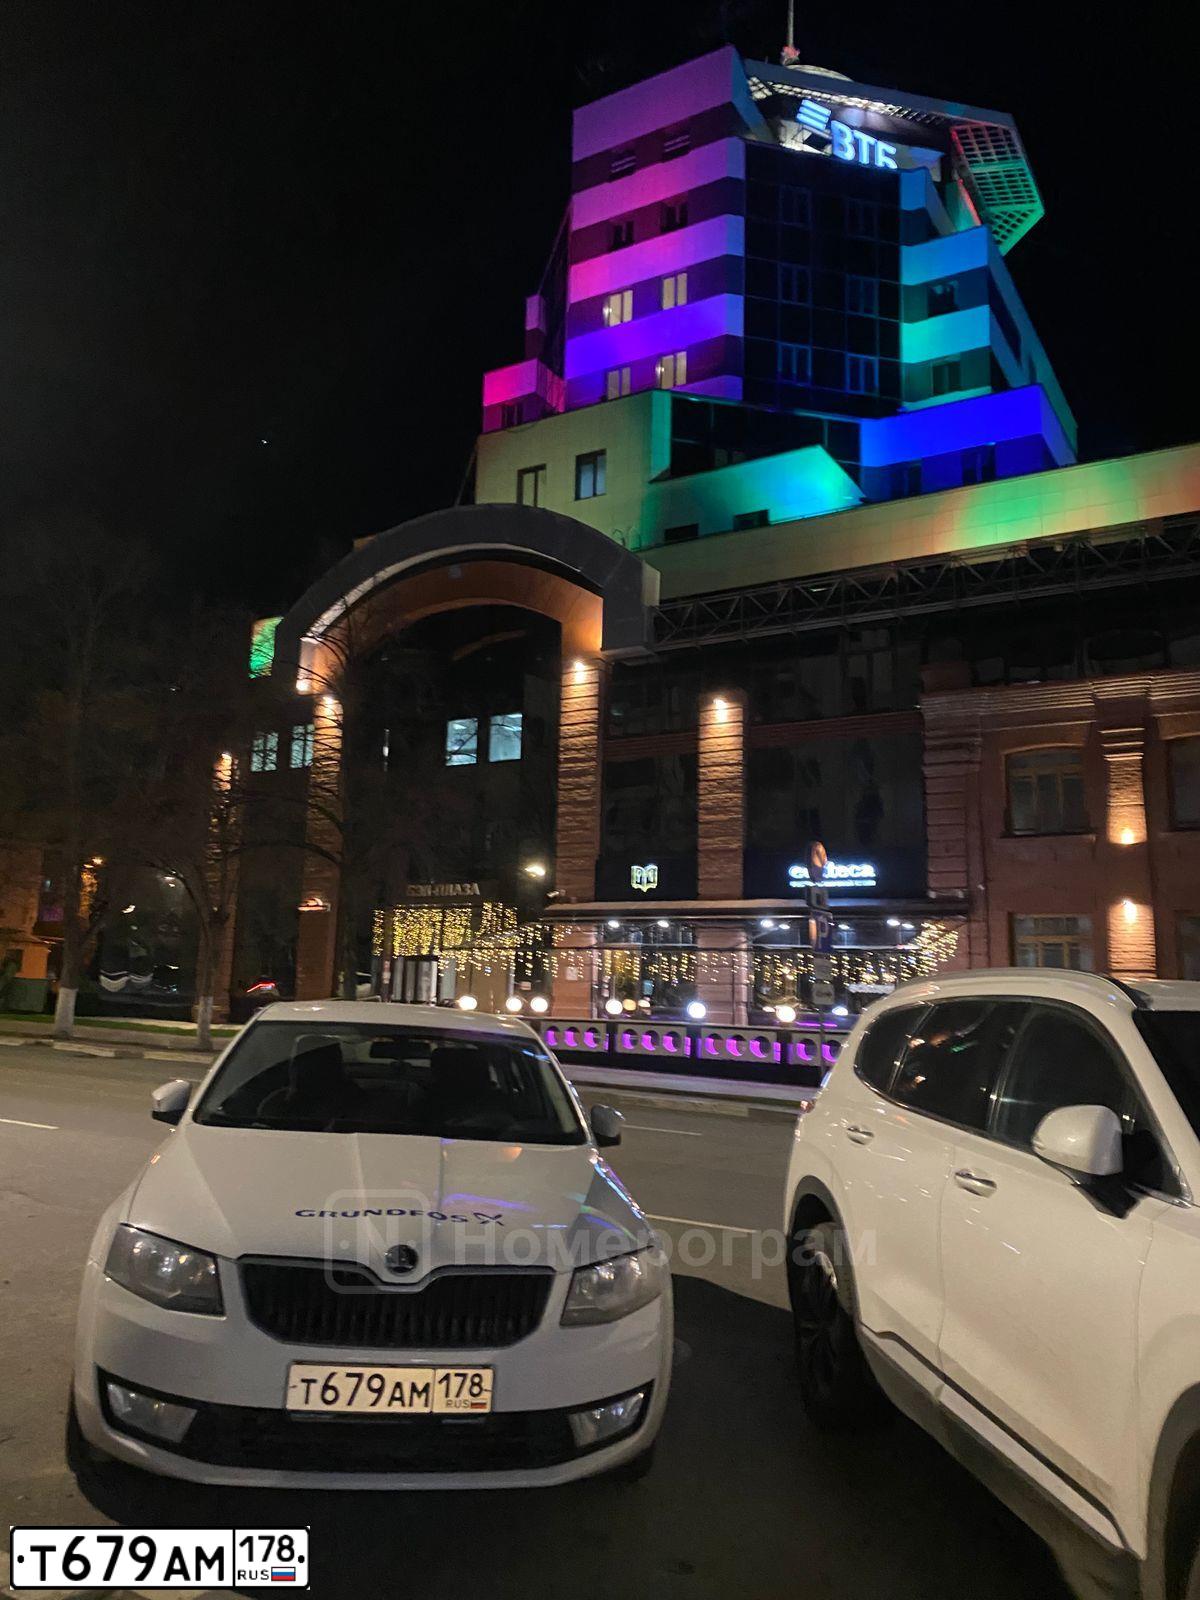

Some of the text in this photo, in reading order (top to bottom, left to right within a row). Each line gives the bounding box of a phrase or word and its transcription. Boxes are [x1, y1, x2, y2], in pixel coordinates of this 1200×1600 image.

[831, 120, 898, 169] ВТБ
[295, 1208, 469, 1223] GRUNDFOS
[301, 1372, 484, 1407] Т679АМ 178
[445, 1399, 470, 1408] RUS
